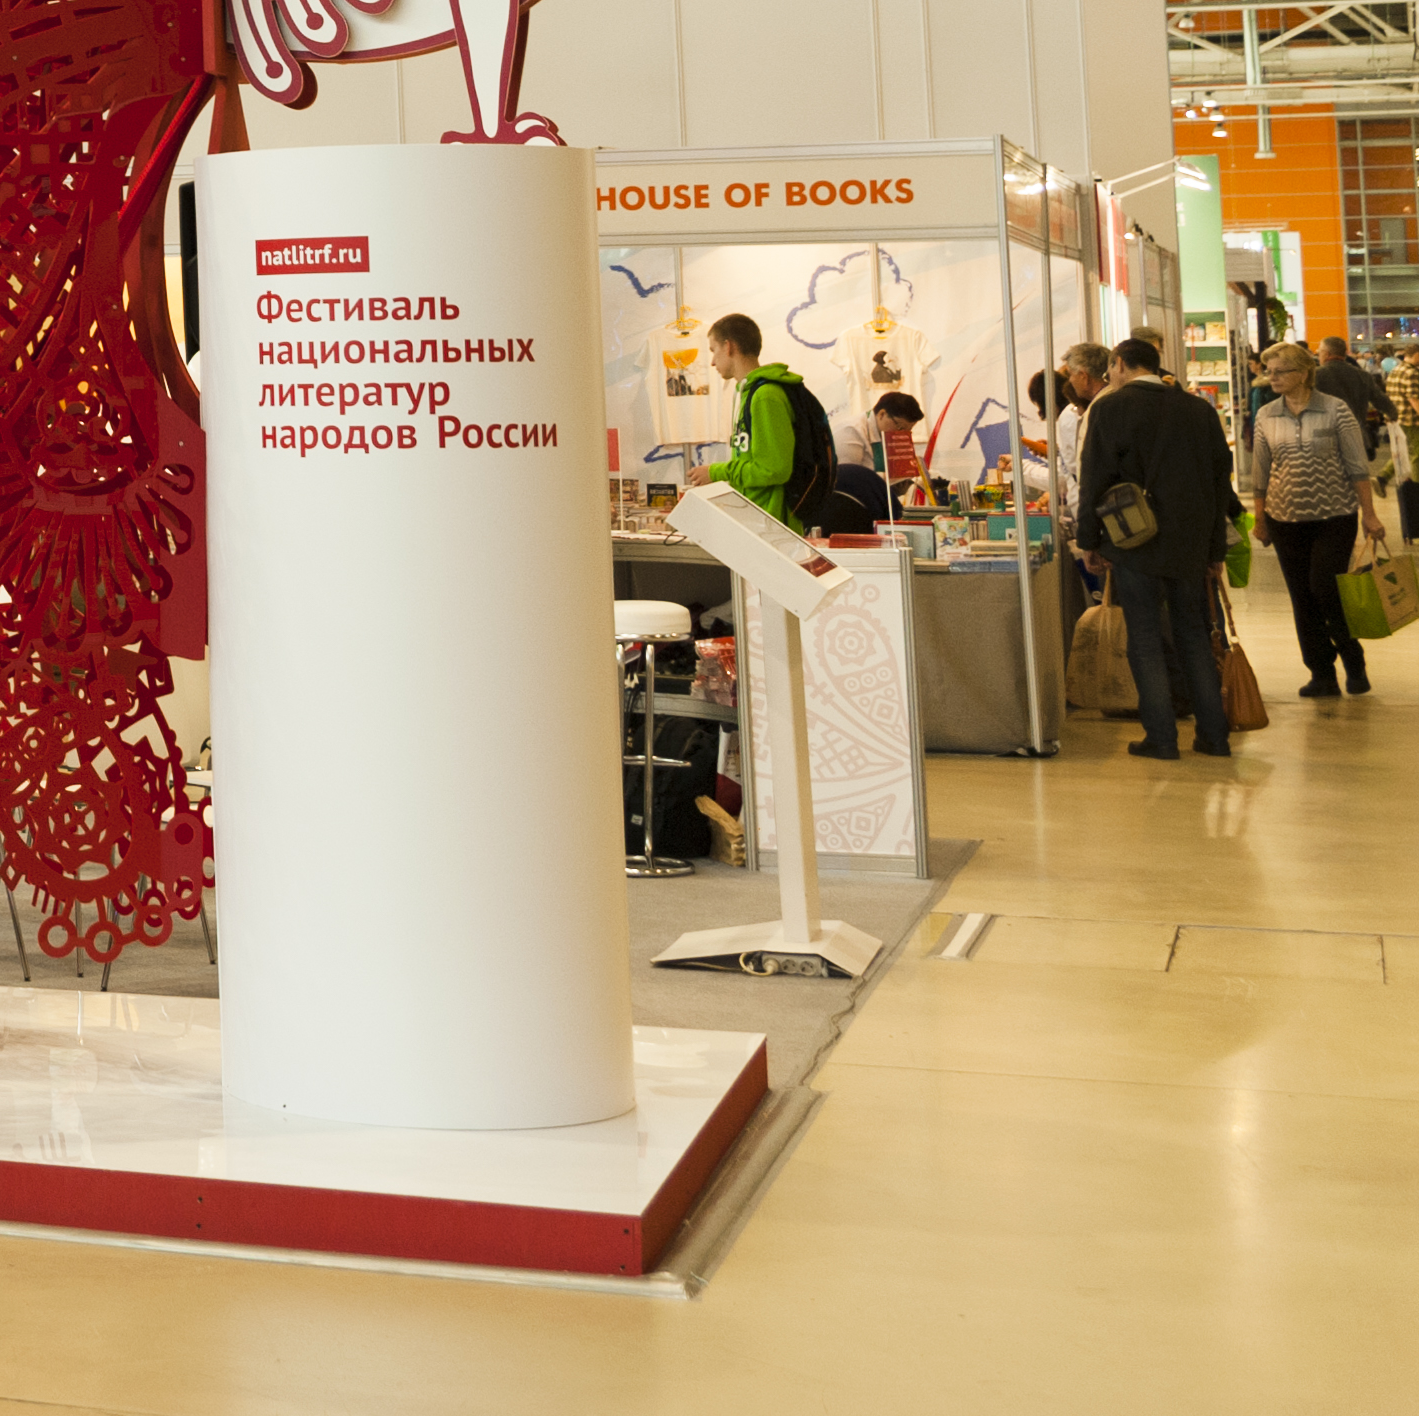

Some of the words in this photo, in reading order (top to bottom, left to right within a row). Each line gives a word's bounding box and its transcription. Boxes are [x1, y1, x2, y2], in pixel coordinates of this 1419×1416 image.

[597, 183, 710, 212] HOUSE
[724, 182, 770, 209] OF
[785, 178, 915, 207] BOOKS
[261, 243, 362, 267] natlitrf.ru
[256, 290, 460, 324] Фестиваль
[258, 338, 536, 369] национальных
[258, 381, 450, 415] литератур
[261, 424, 417, 458] народов
[437, 415, 558, 449] России
